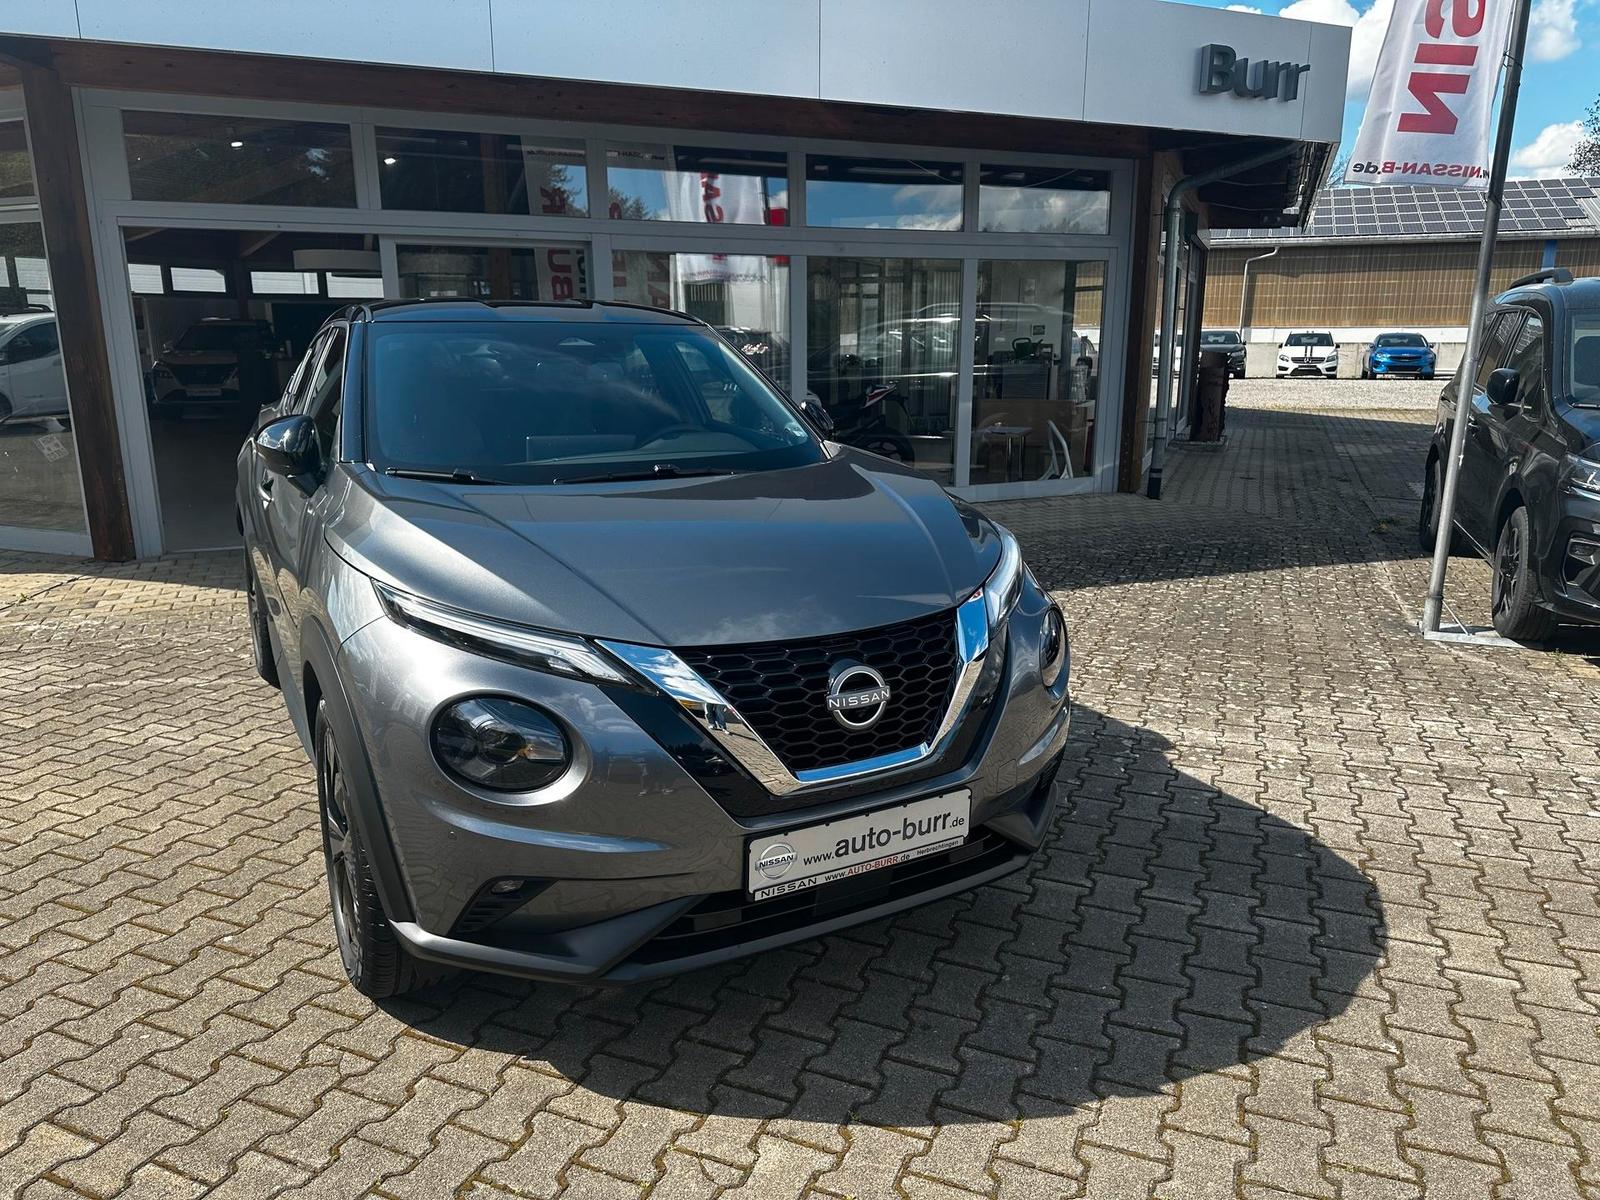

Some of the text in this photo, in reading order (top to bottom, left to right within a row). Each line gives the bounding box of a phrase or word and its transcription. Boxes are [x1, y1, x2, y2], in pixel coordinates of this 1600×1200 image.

[1200, 43, 1311, 102] Burr
[828, 688, 891, 709] NISSAN
[758, 853, 795, 869] NISSAN
[802, 811, 965, 866] www.auto-burr.de
[760, 877, 818, 899] NISSAN
[824, 853, 911, 882] www.AUTO-BURR.de
